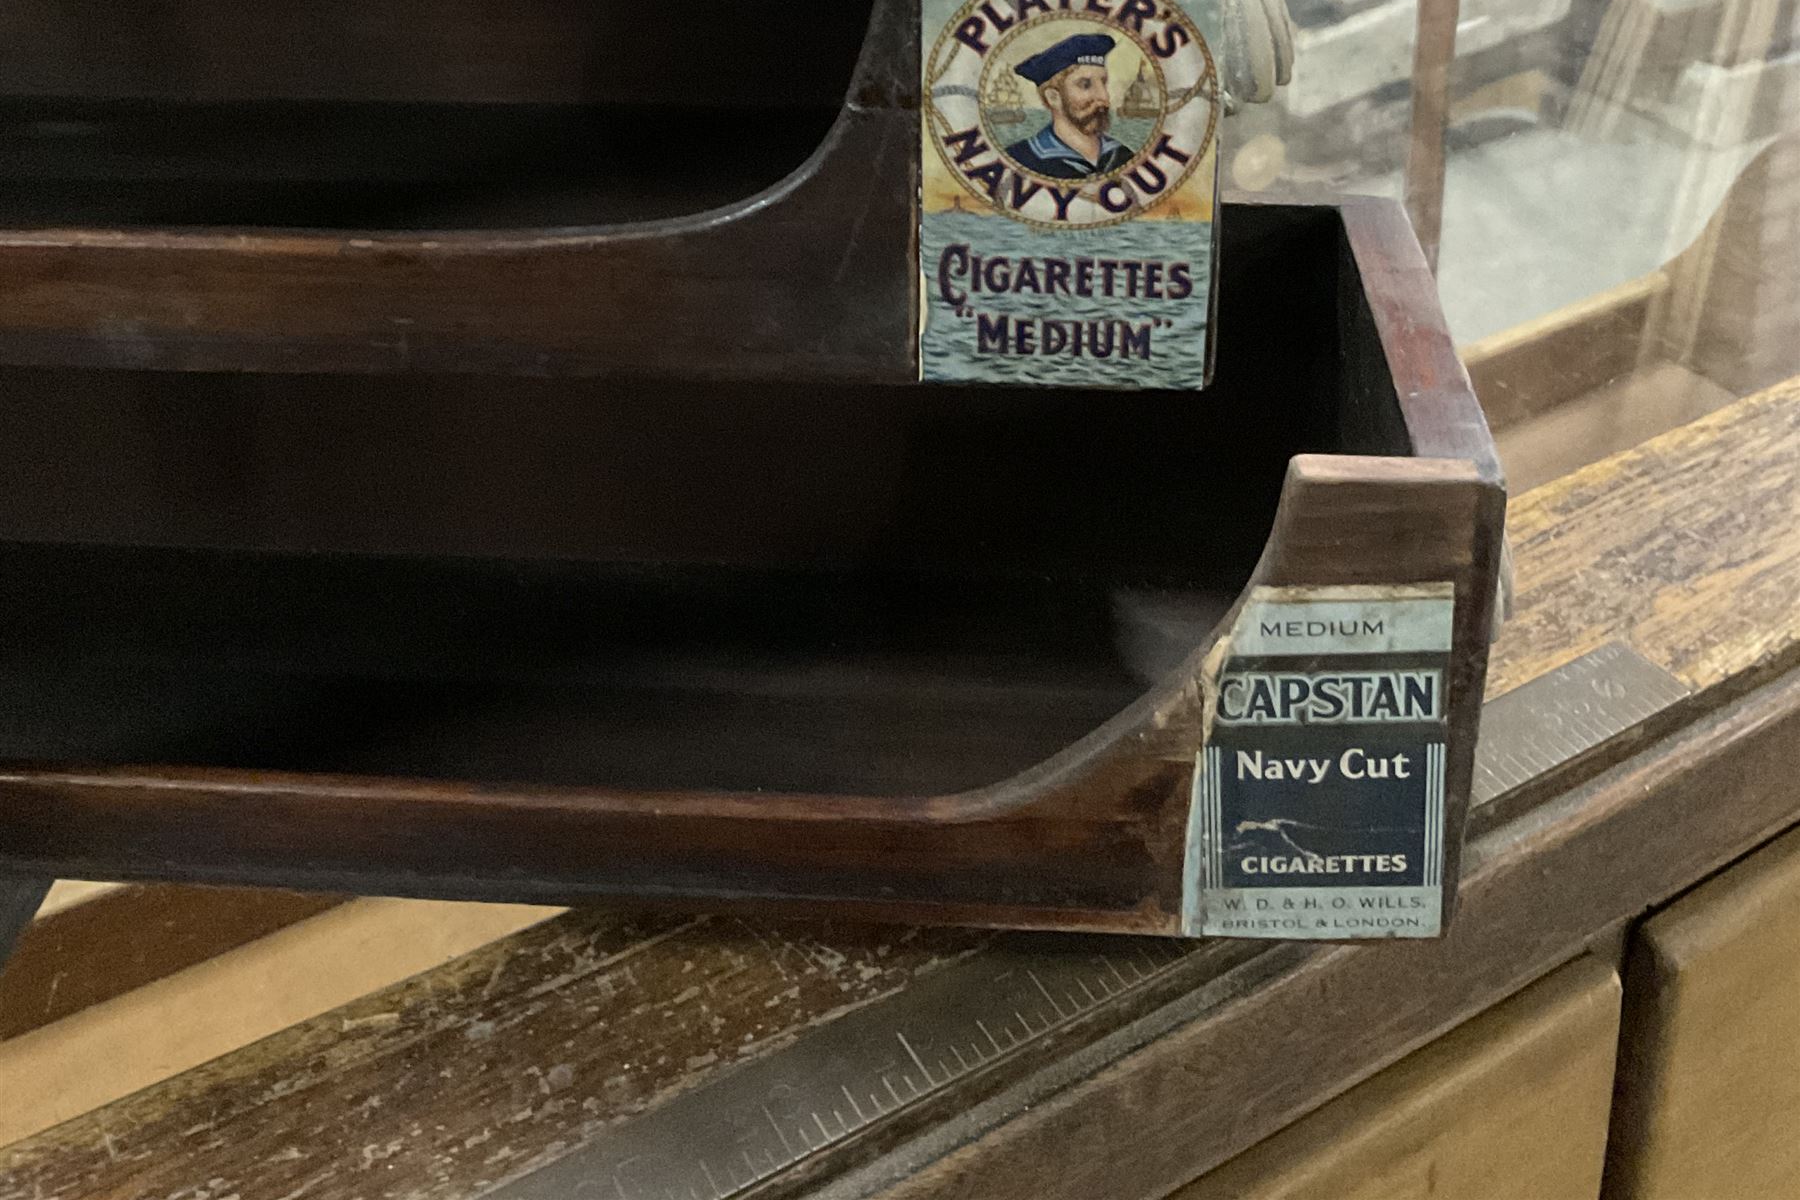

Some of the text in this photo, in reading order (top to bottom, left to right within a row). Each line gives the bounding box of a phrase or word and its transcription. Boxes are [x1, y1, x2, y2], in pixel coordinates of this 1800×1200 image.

[942, 126, 1190, 221] NAVY CUT
[1260, 620, 1384, 637] MEDIUM
[1215, 673, 1436, 722] CAPSTAN
[1236, 748, 1410, 784] Navy Cut
[1241, 854, 1408, 874] CIGARETTES
[1222, 918, 1305, 930] BRISTOL
[1315, 918, 1328, 928] &
